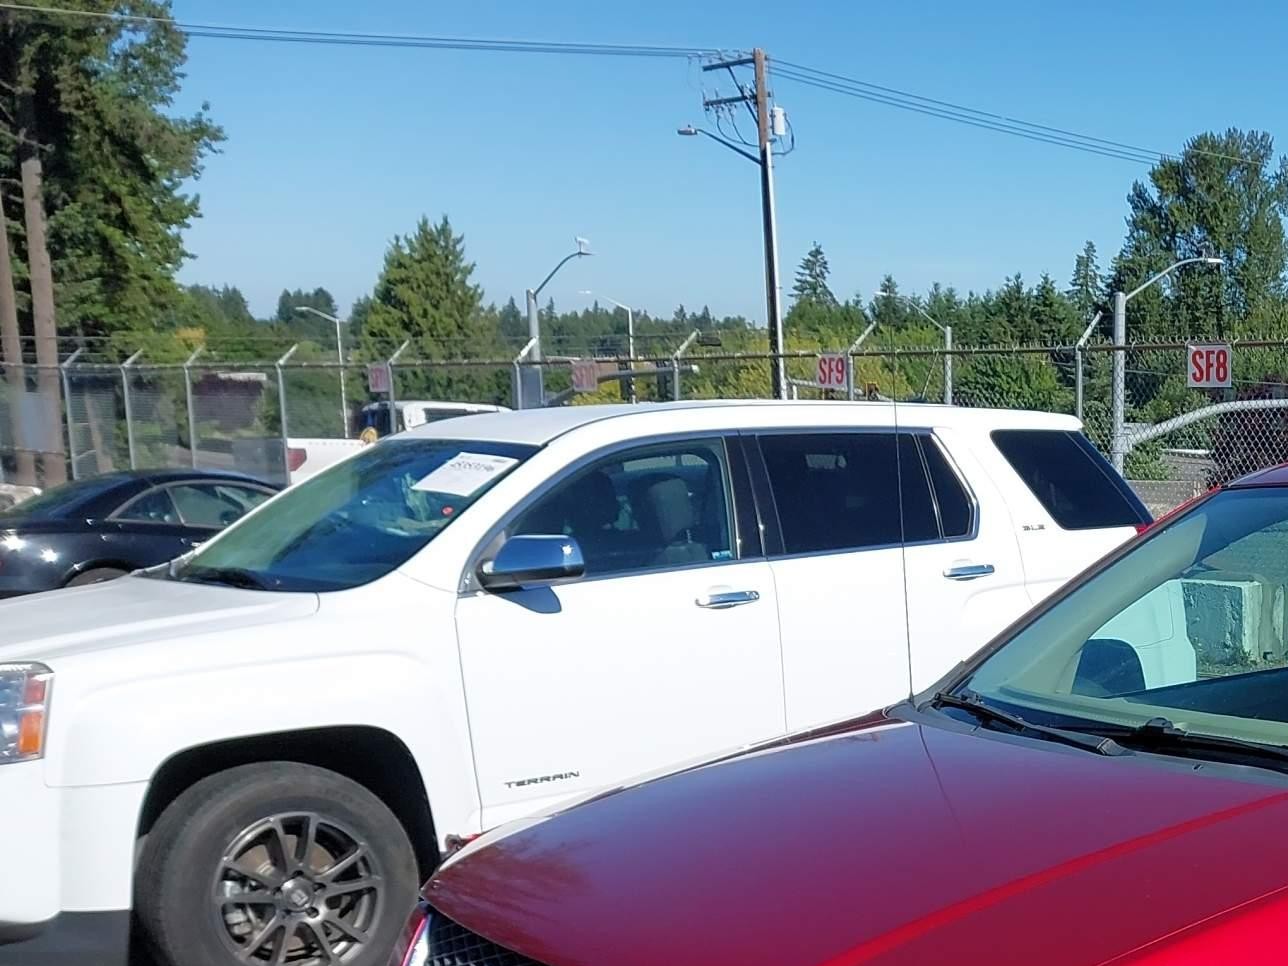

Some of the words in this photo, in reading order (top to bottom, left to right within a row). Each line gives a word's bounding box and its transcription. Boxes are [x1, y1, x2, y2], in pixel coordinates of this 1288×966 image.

[818, 356, 845, 385] SF9
[1191, 349, 1228, 383] SF8
[504, 771, 580, 788] TERRAIN
